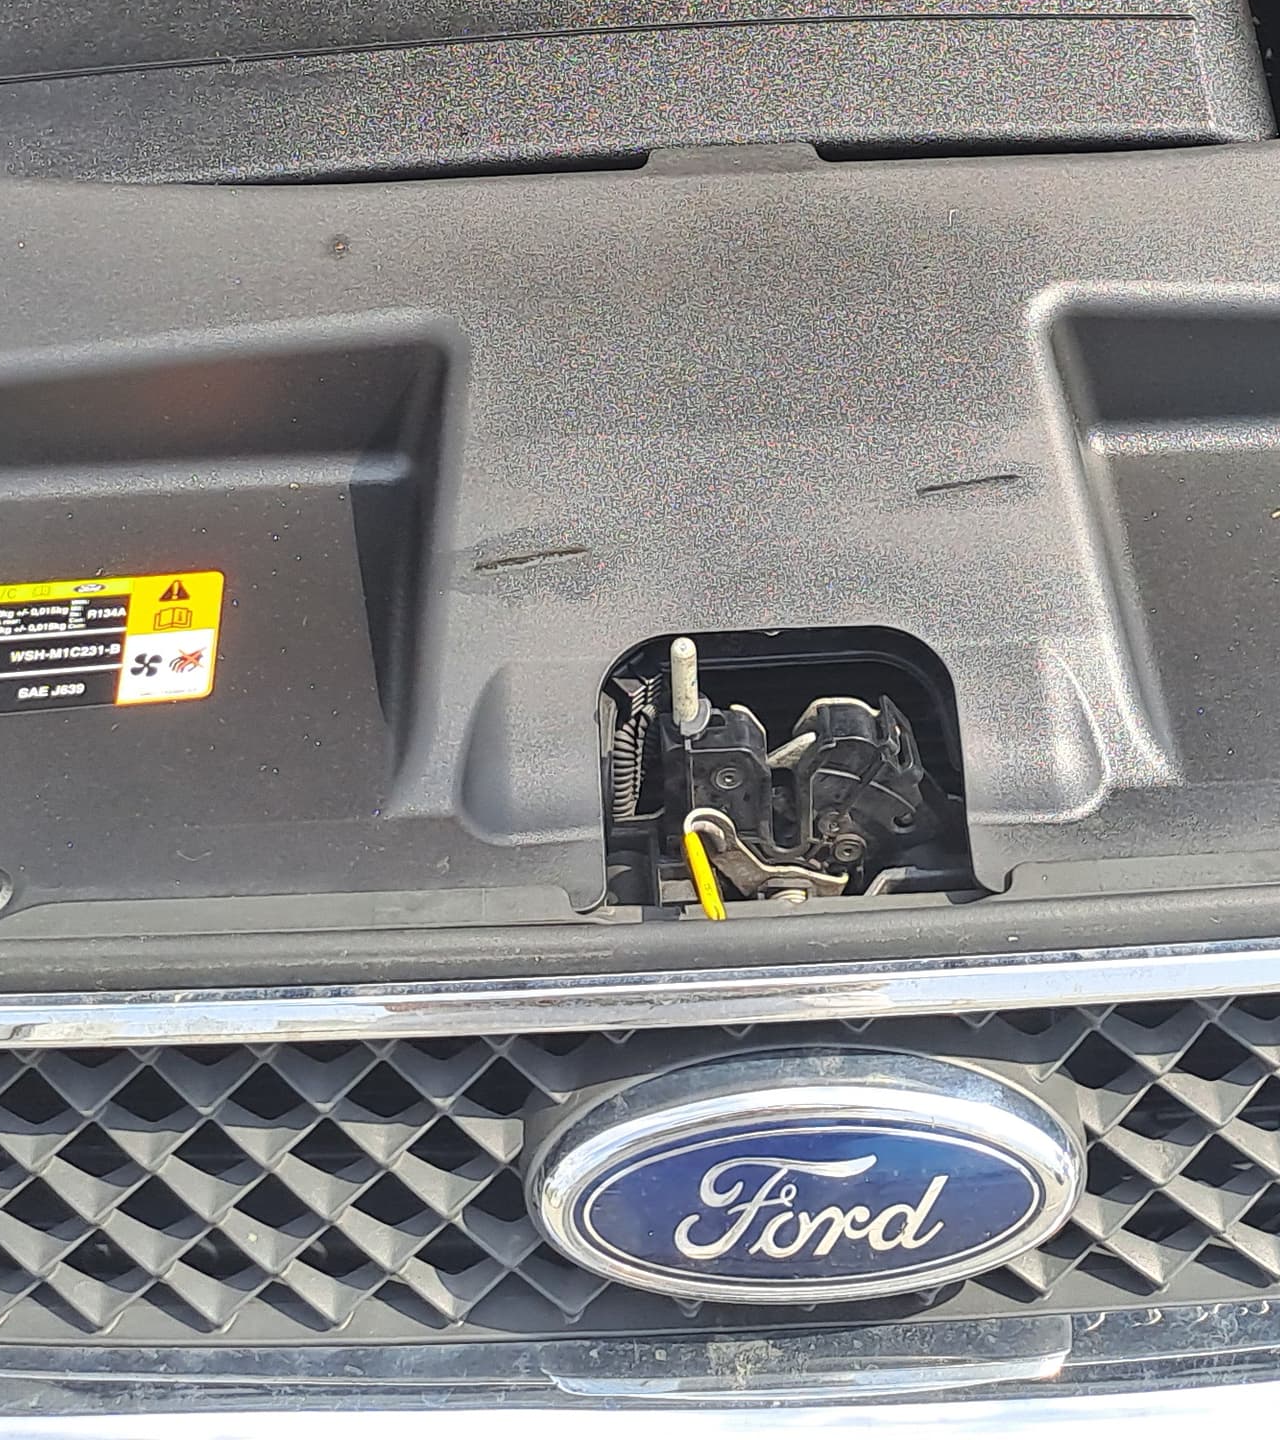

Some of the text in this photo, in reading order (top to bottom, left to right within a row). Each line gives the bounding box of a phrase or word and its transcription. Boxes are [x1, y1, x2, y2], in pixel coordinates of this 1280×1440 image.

[87, 606, 127, 620] R134A
[10, 642, 121, 664] WSH-M1C231-B
[17, 682, 86, 700] SAE J639
[674, 1155, 949, 1260] Ford
